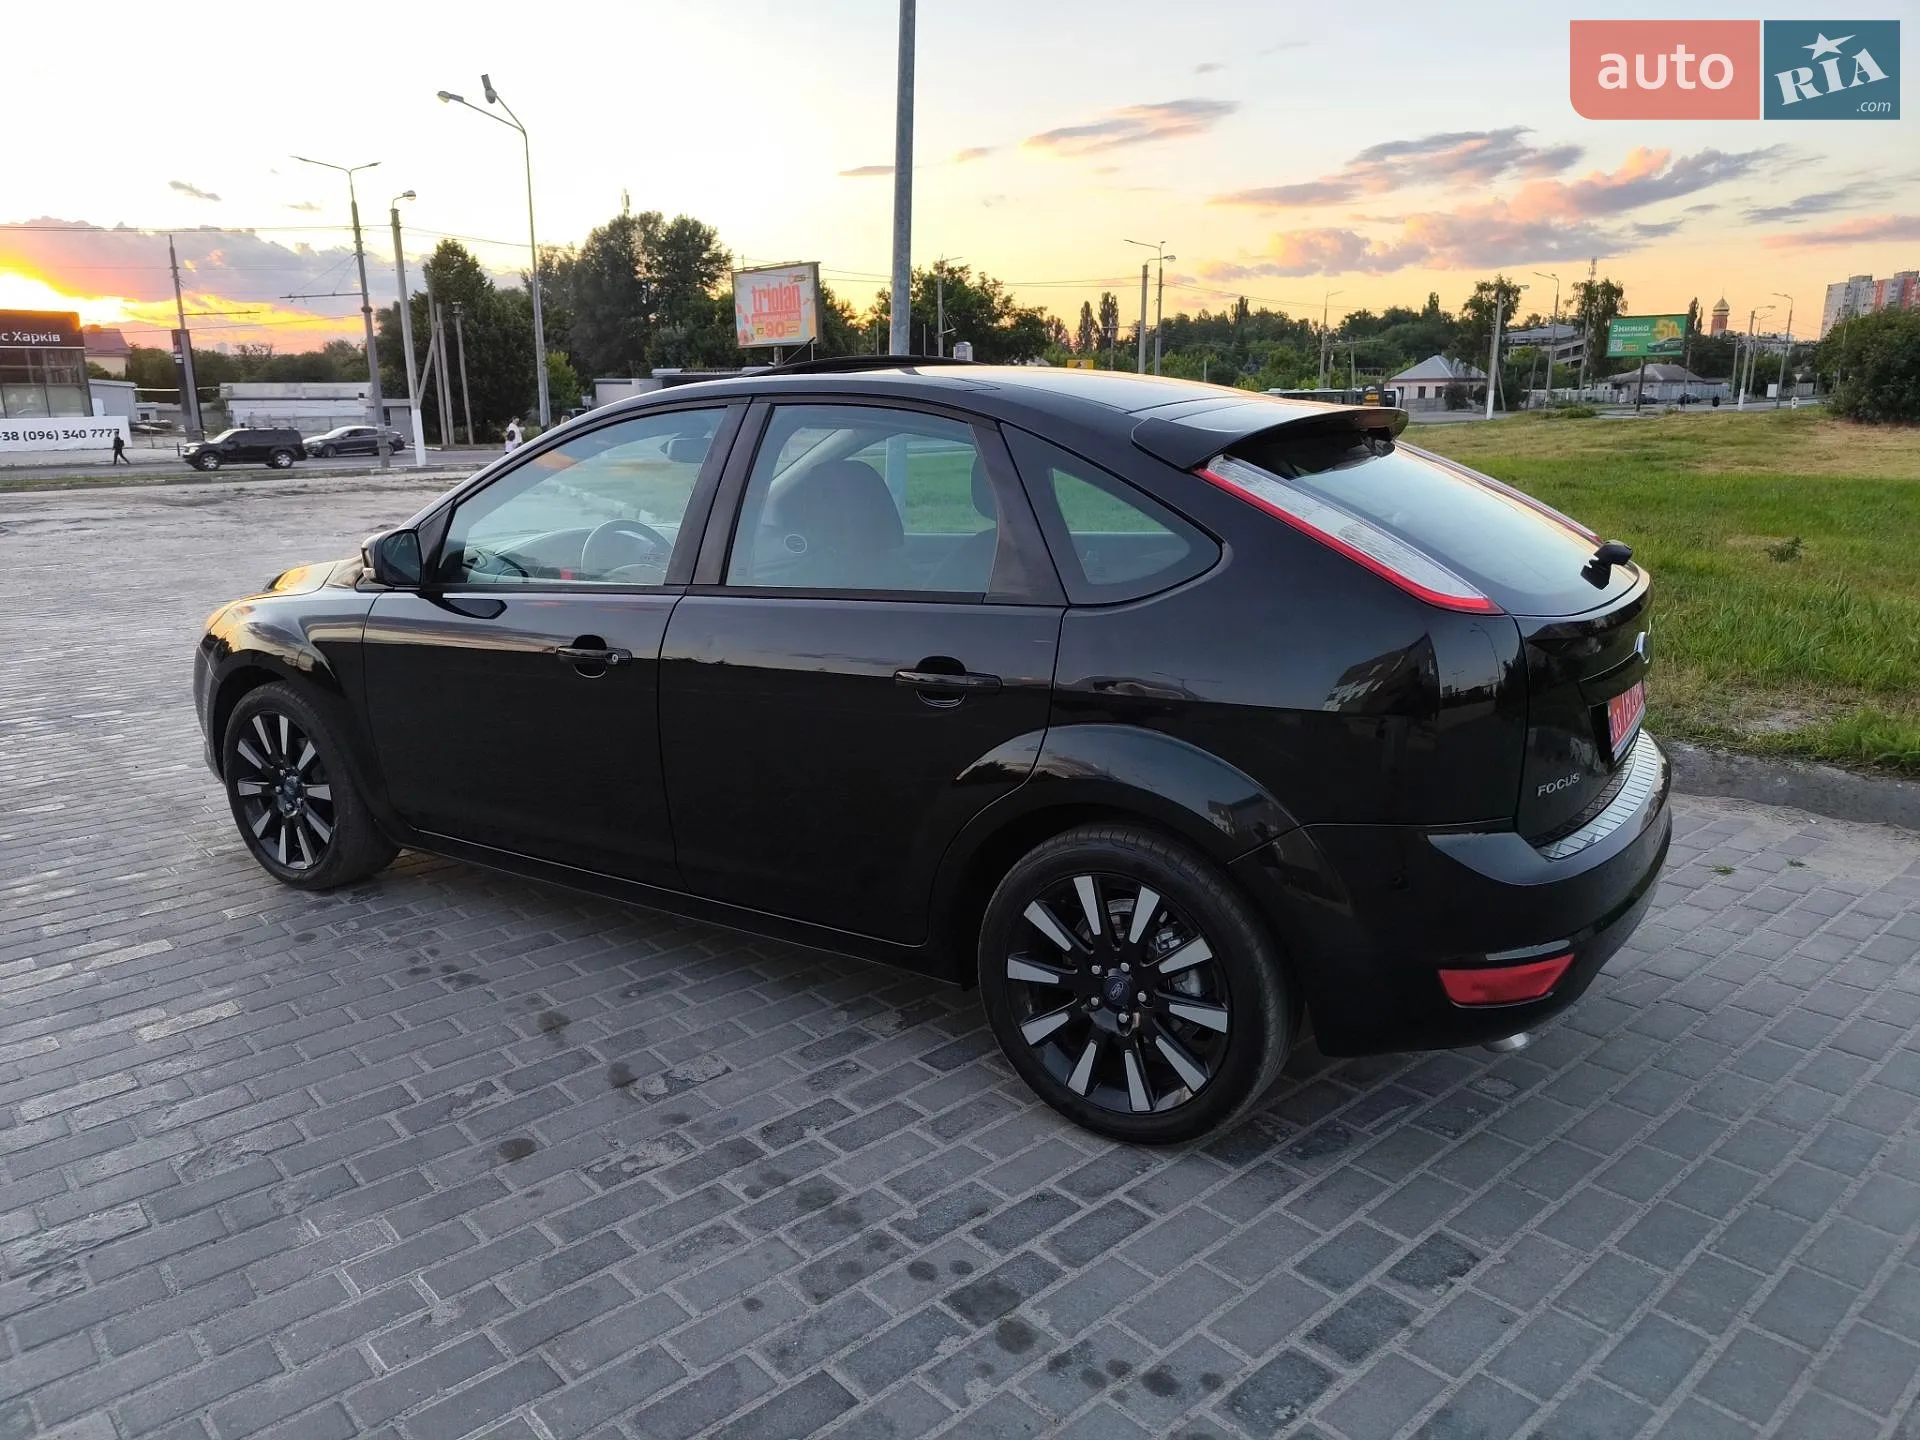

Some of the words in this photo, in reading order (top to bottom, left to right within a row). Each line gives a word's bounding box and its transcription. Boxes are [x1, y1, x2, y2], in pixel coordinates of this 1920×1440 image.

[12, 331, 61, 344] Харків
[23, 430, 59, 441] (096)
[62, 429, 87, 439] 340
[1537, 772, 1580, 797] FOCUS
